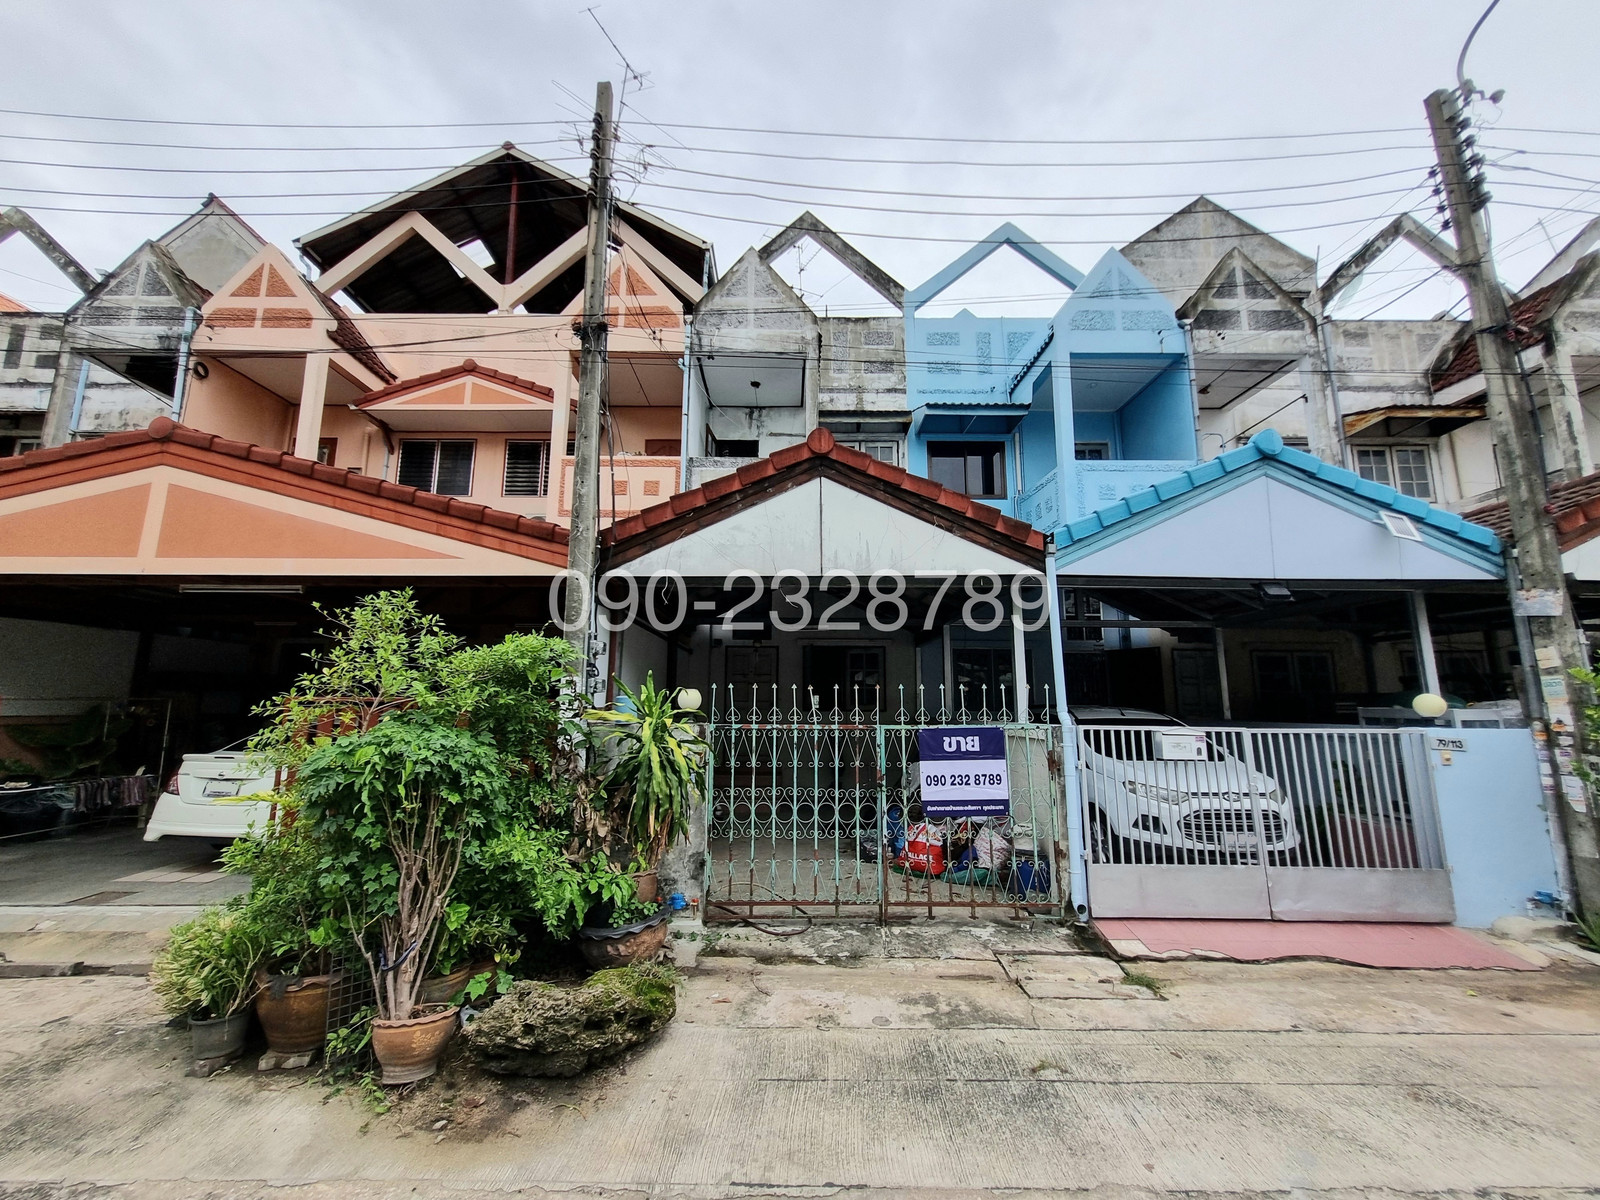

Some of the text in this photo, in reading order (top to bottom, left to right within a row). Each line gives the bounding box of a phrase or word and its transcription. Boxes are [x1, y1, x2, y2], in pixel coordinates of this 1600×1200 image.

[942, 736, 980, 752] ขาย
[1436, 738, 1464, 749] 79/113
[925, 773, 1002, 787] 090 232 8789
